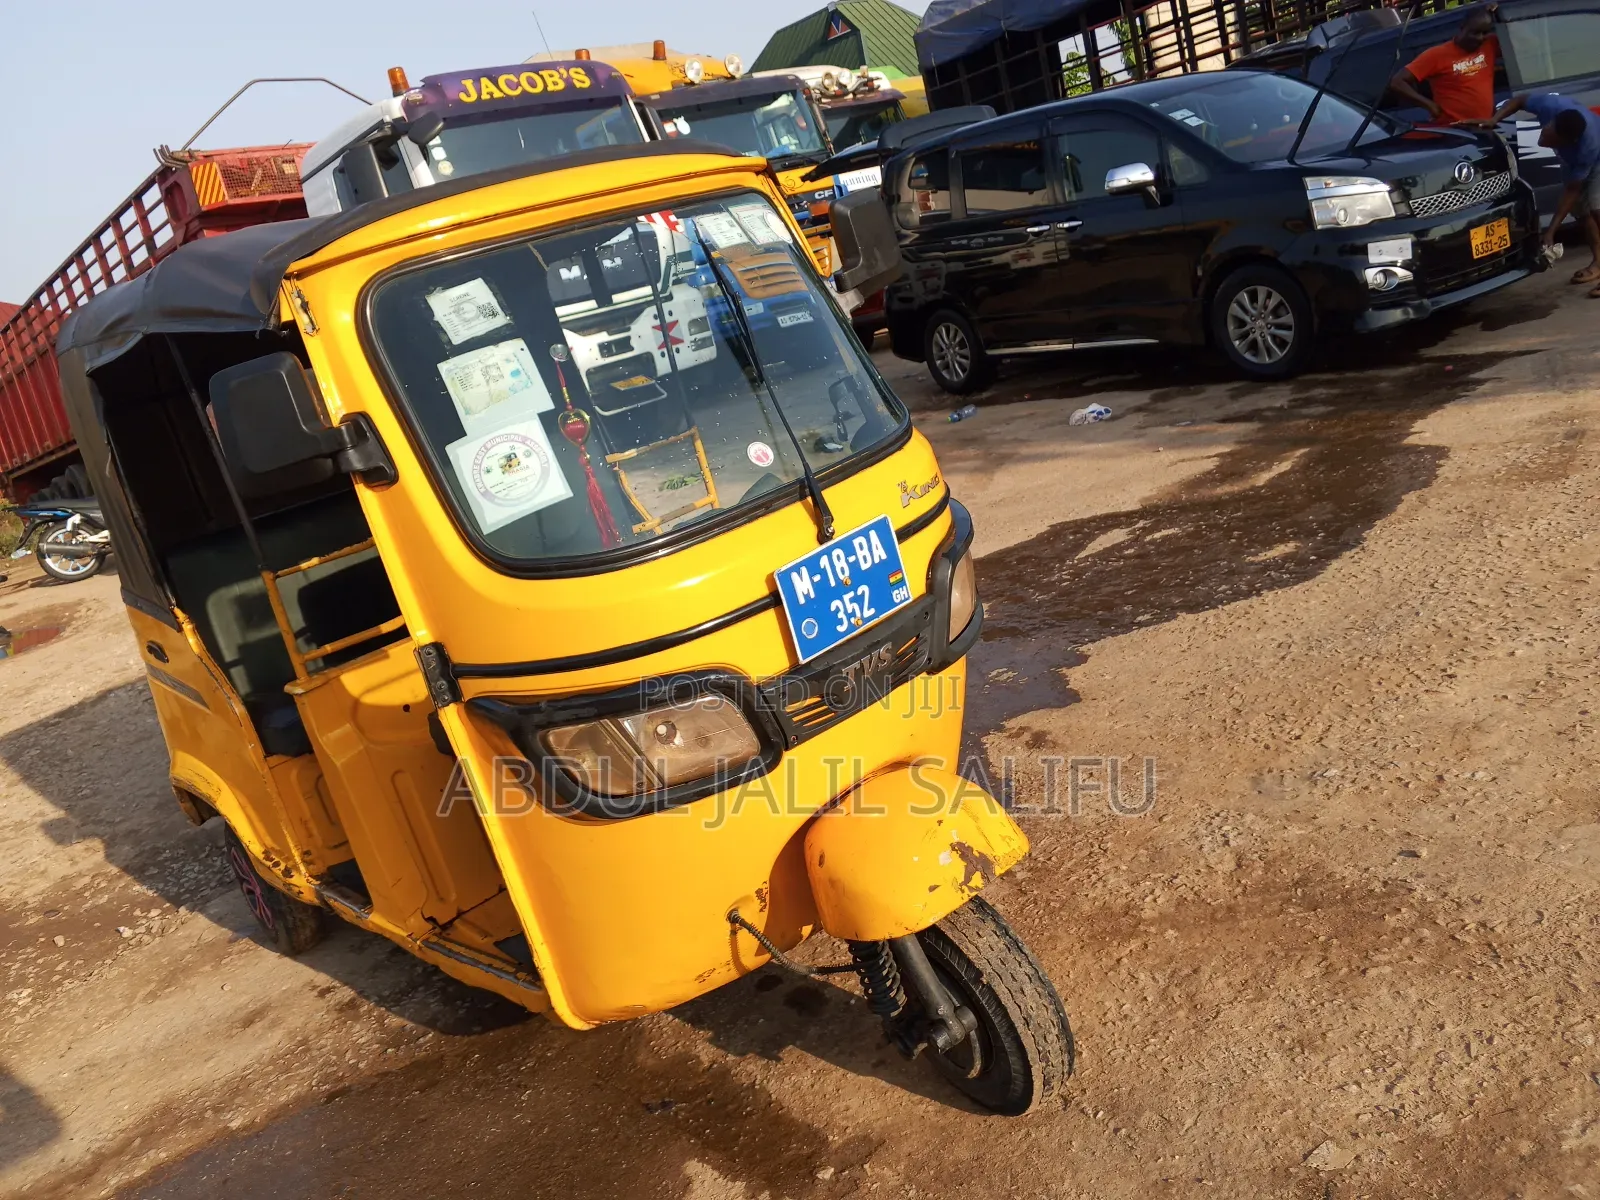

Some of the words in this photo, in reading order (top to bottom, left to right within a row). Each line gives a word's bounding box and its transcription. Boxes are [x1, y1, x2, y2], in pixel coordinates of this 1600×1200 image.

[458, 67, 591, 103] JACOB'S
[1474, 234, 1508, 256] 8331-25
[1485, 224, 1495, 239] AS
[484, 433, 523, 448] MUNICIPAL
[790, 529, 887, 605] M-18-BA
[830, 584, 876, 632] 352
[891, 586, 909, 603] GH
[841, 641, 893, 692] TVS
